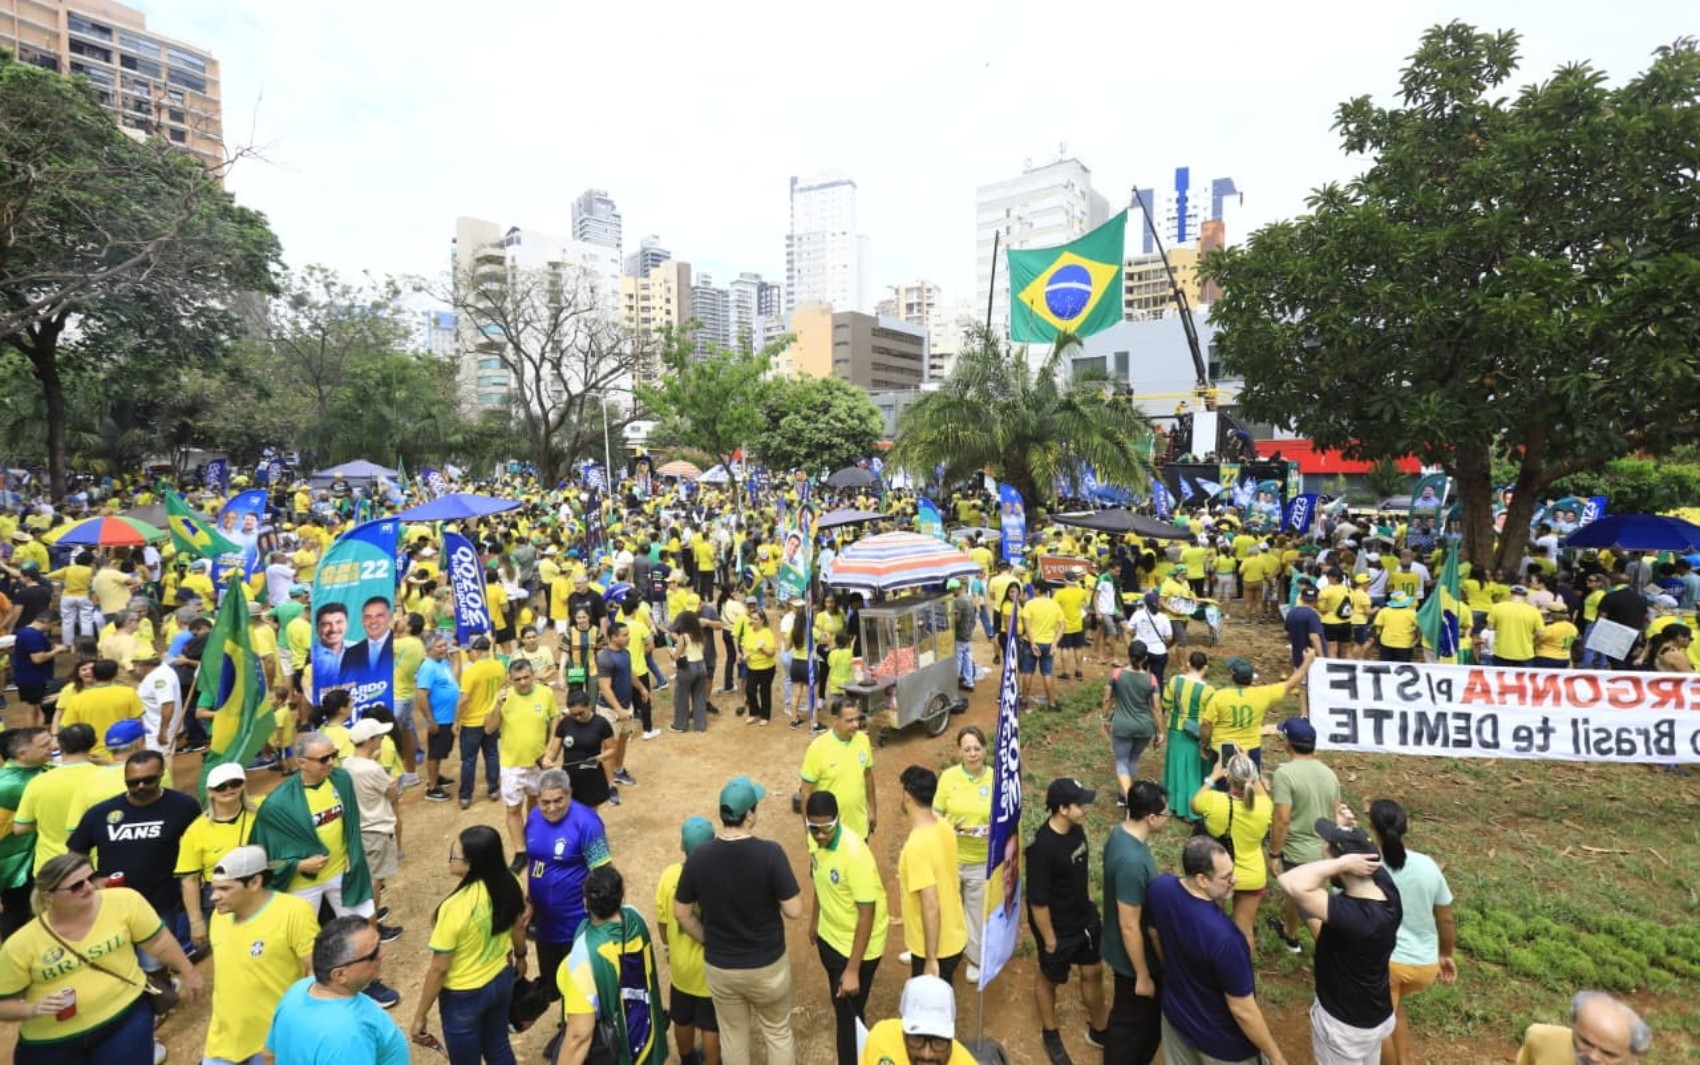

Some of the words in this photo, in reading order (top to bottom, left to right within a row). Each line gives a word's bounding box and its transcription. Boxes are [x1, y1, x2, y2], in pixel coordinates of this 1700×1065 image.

[360, 559, 389, 580] 22
[456, 582, 470, 627] Leandro
[457, 546, 488, 630] 30700
[1008, 636, 1021, 816] 30700
[1230, 704, 1254, 728] 10
[997, 722, 1009, 822] Leandro
[107, 820, 165, 842] VANS
[531, 859, 546, 879] 10
